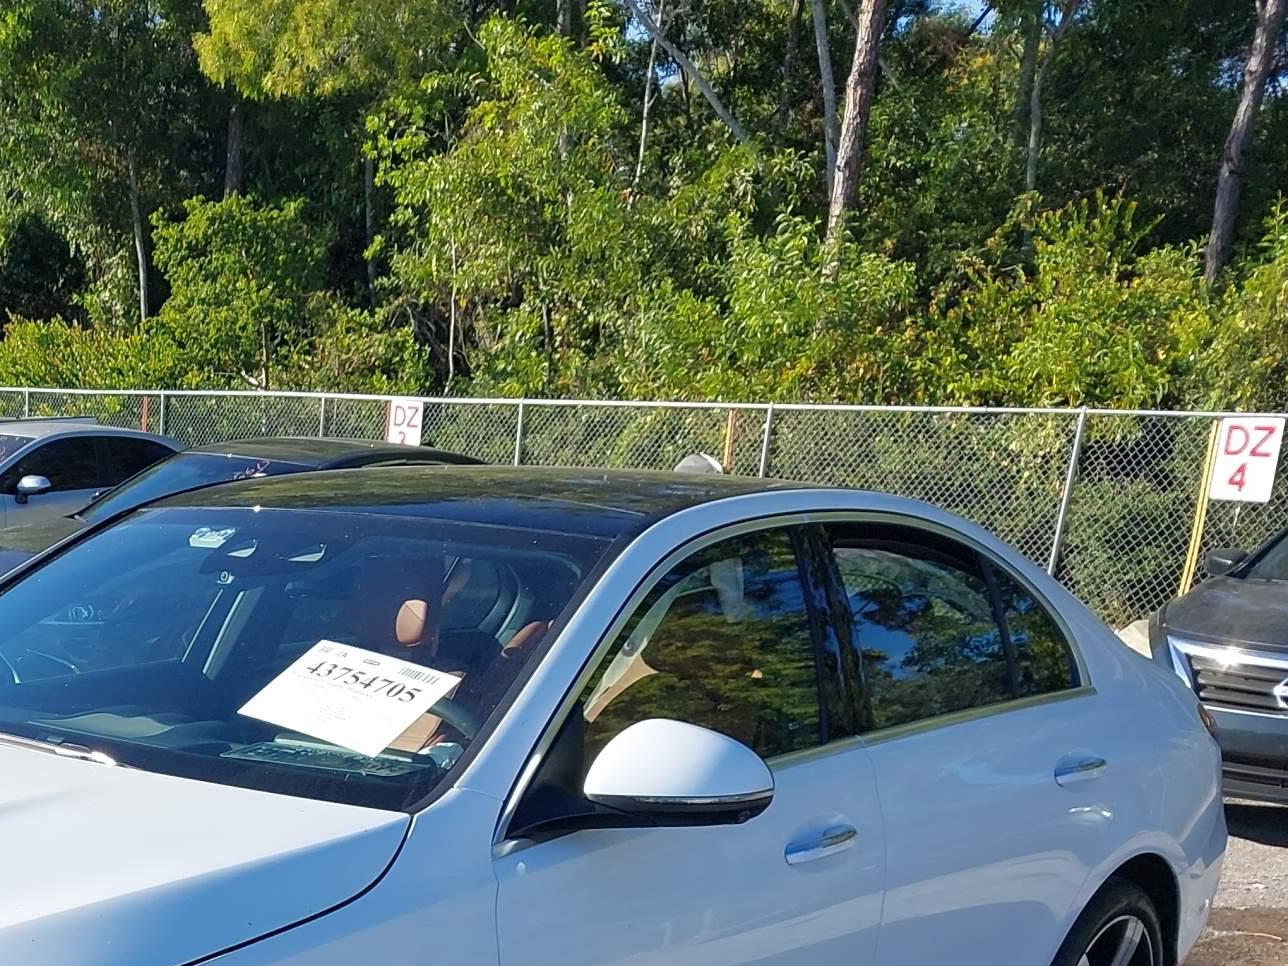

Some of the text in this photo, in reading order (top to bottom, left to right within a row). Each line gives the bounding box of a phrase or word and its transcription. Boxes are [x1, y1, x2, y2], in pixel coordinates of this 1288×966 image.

[393, 405, 419, 428] DZ
[1224, 424, 1277, 457] DZ
[1227, 462, 1248, 492] 4
[306, 660, 423, 703] 43754705
